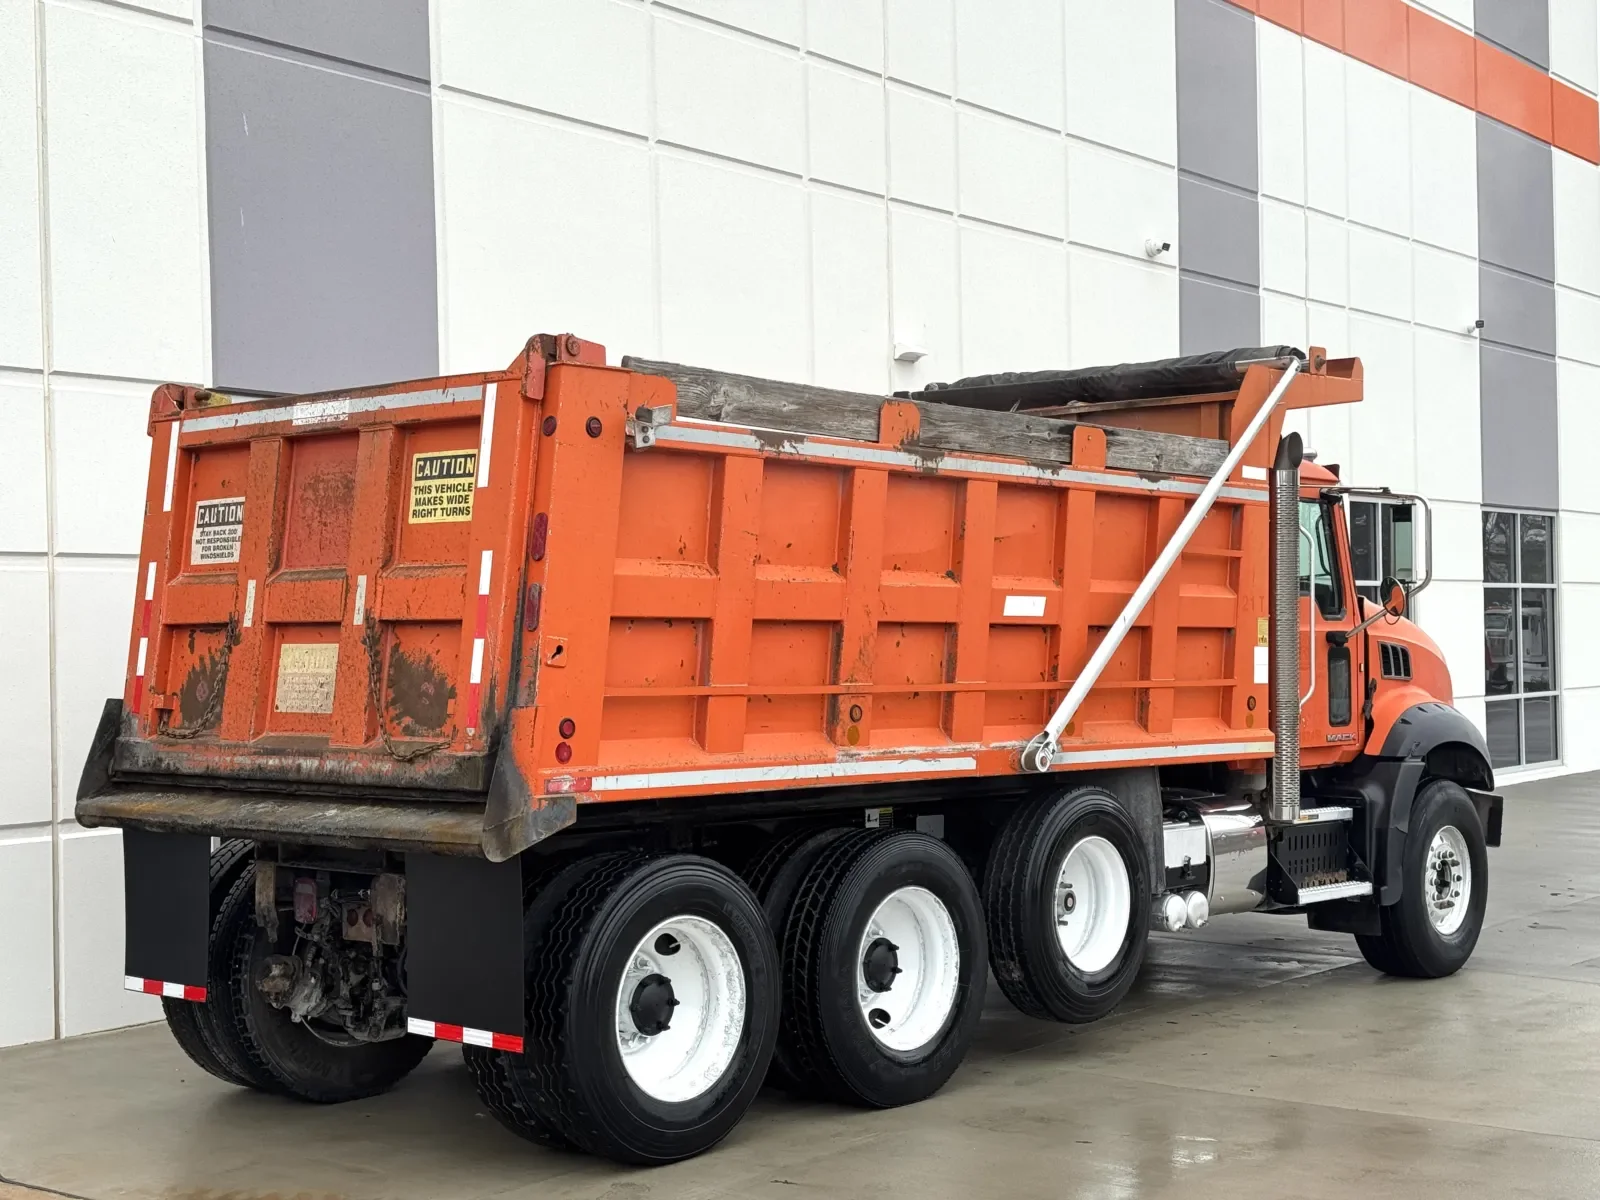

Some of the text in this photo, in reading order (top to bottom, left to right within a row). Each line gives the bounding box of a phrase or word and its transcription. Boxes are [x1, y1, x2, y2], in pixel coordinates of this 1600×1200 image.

[416, 457, 475, 477] CAUTION
[414, 482, 473, 495] THIS VEHICLE
[415, 494, 470, 507] MAKES WIDE
[198, 505, 244, 524] CAUTION
[412, 506, 471, 518] RIGHT TURNS
[207, 536, 241, 544] RESPONSIBLE
[213, 544, 234, 552] BROKEN
[200, 552, 234, 560] WINDSHIELDS
[1326, 733, 1356, 742] MACK
